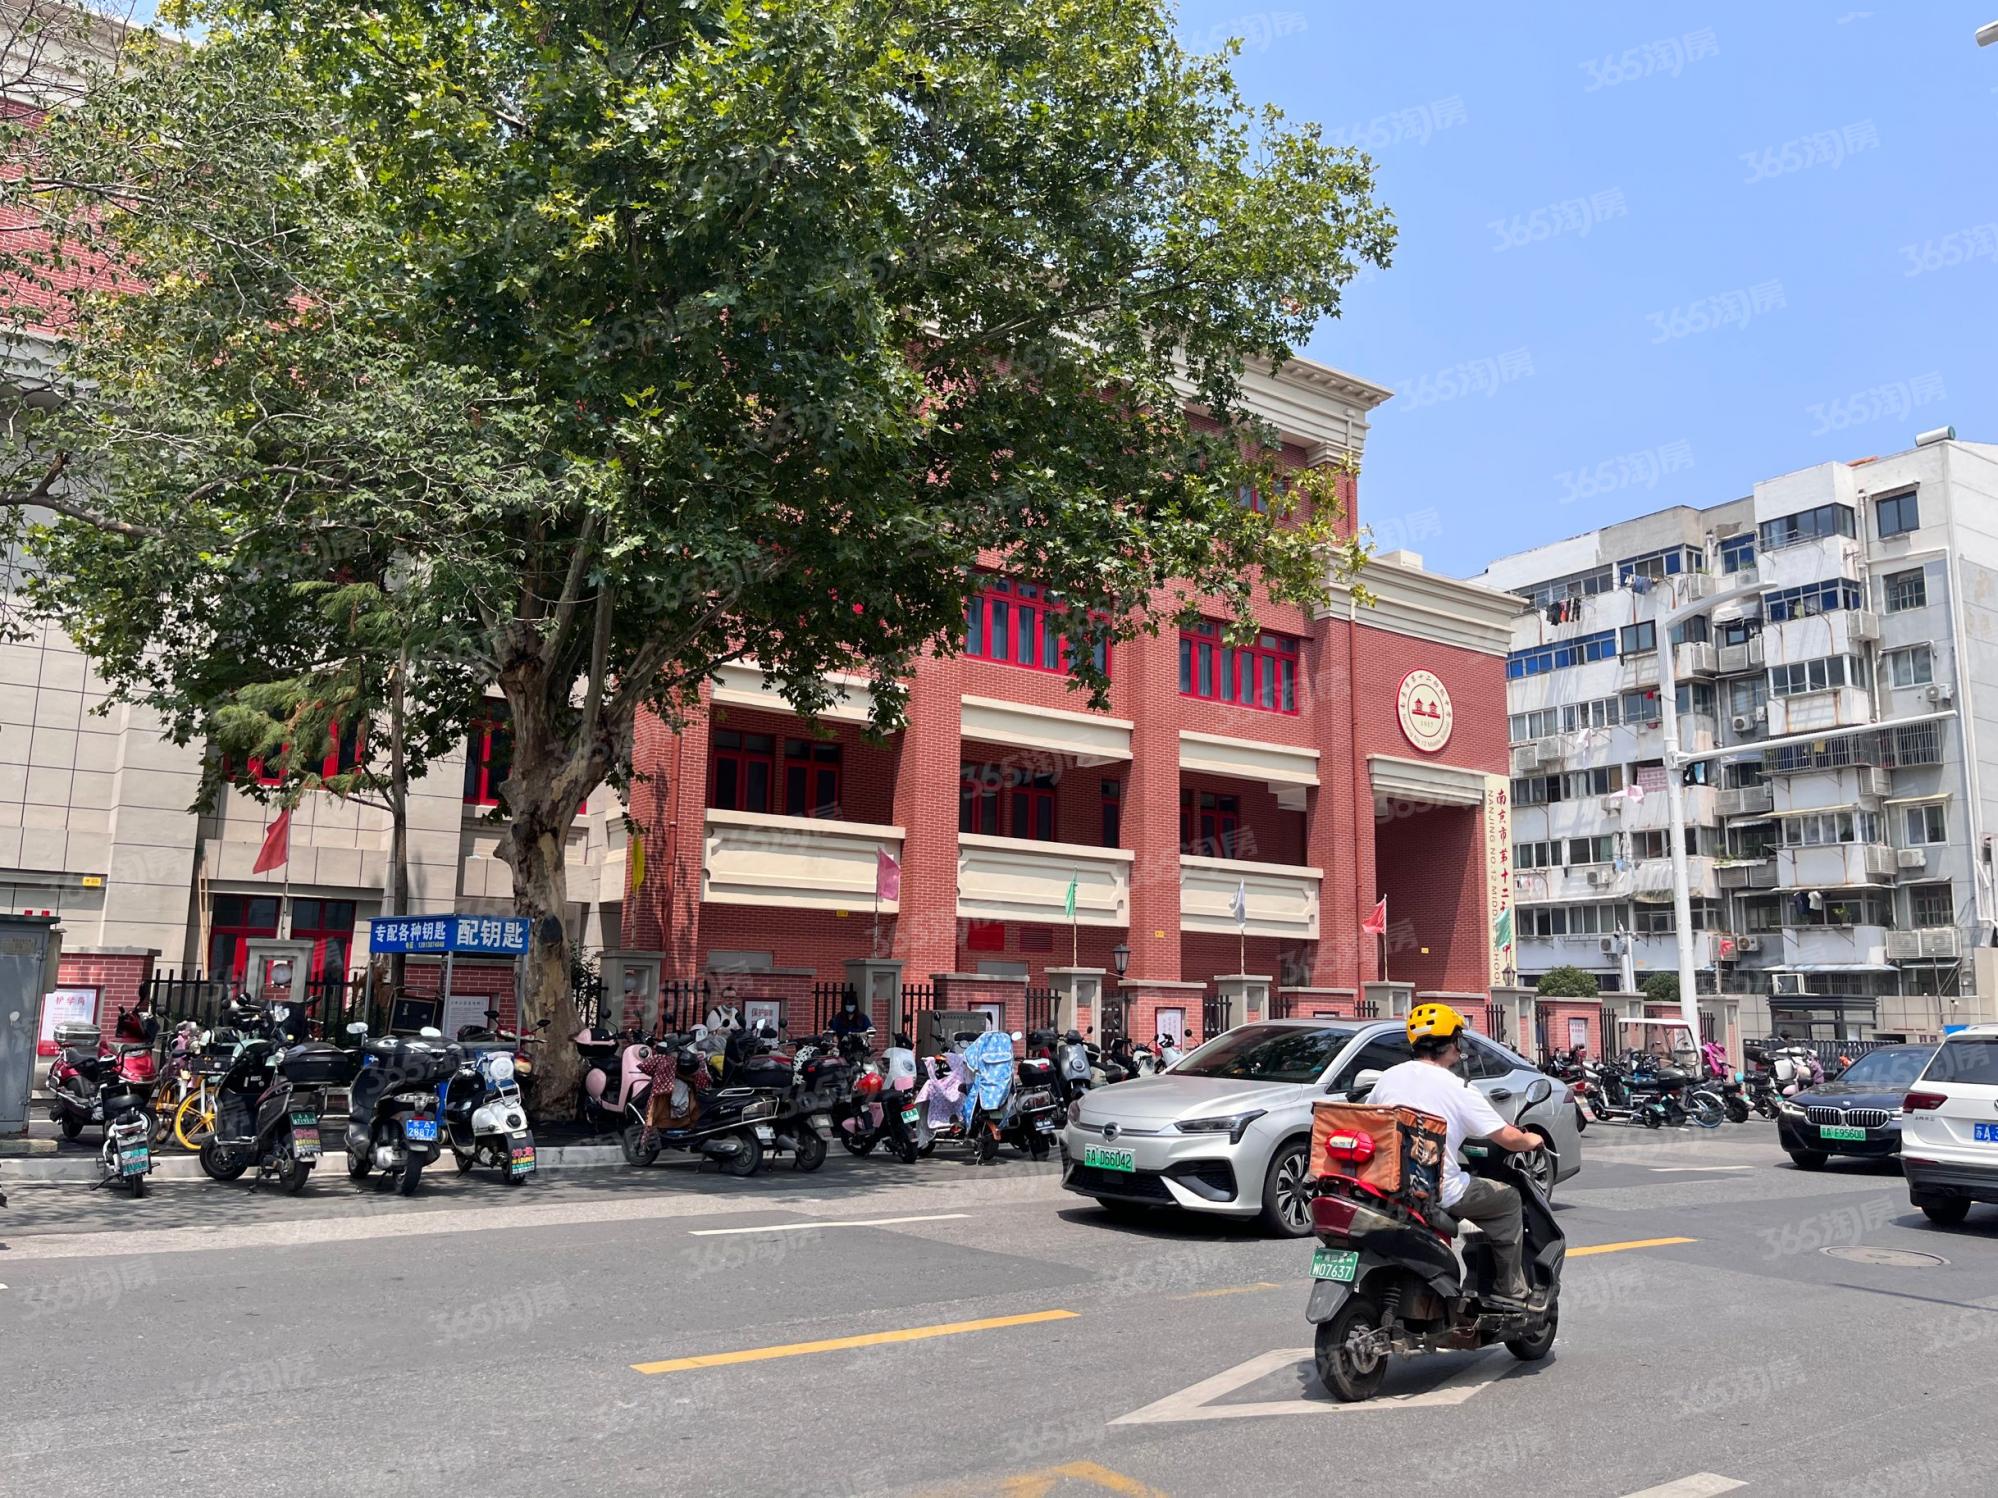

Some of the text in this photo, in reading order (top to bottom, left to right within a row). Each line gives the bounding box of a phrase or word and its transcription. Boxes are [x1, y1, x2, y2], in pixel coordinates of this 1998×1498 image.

[1488, 790, 1496, 842] NANJING
[375, 921, 446, 943] 专配各种钥匙
[456, 919, 524, 949] 配钥匙
[1312, 1263, 1353, 1278] W07637
